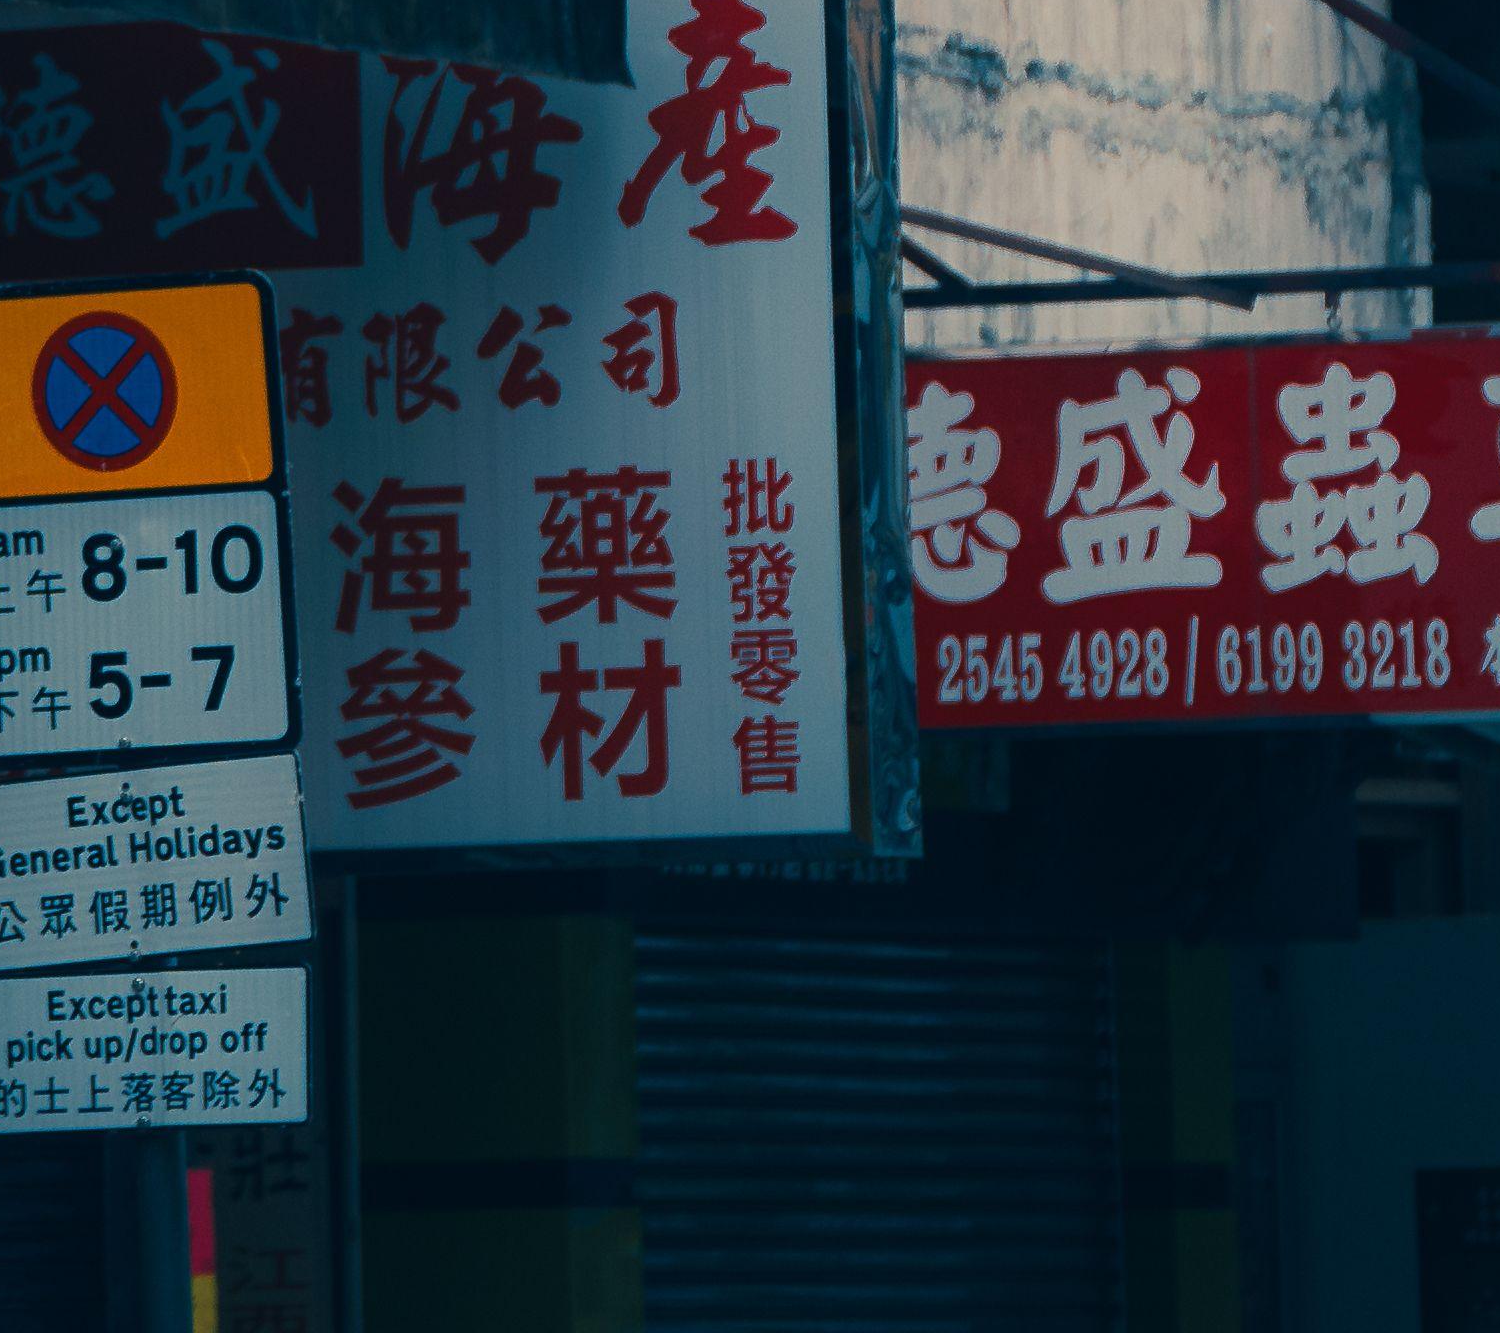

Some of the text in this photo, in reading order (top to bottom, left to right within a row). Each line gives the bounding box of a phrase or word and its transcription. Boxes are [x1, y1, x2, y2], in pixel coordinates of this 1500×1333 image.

[81, 523, 265, 603] 8-10
[721, 456, 801, 797] 批發零售
[937, 633, 1044, 703] 2545
[1058, 627, 1170, 700] 4928
[1216, 620, 1324, 695] 6199
[1342, 617, 1452, 691] 3218
[66, 786, 187, 830] Except
[129, 821, 287, 865] Holidays
[46, 983, 228, 1023] Except taxi
[6, 1021, 269, 1069] pick up/drop off
